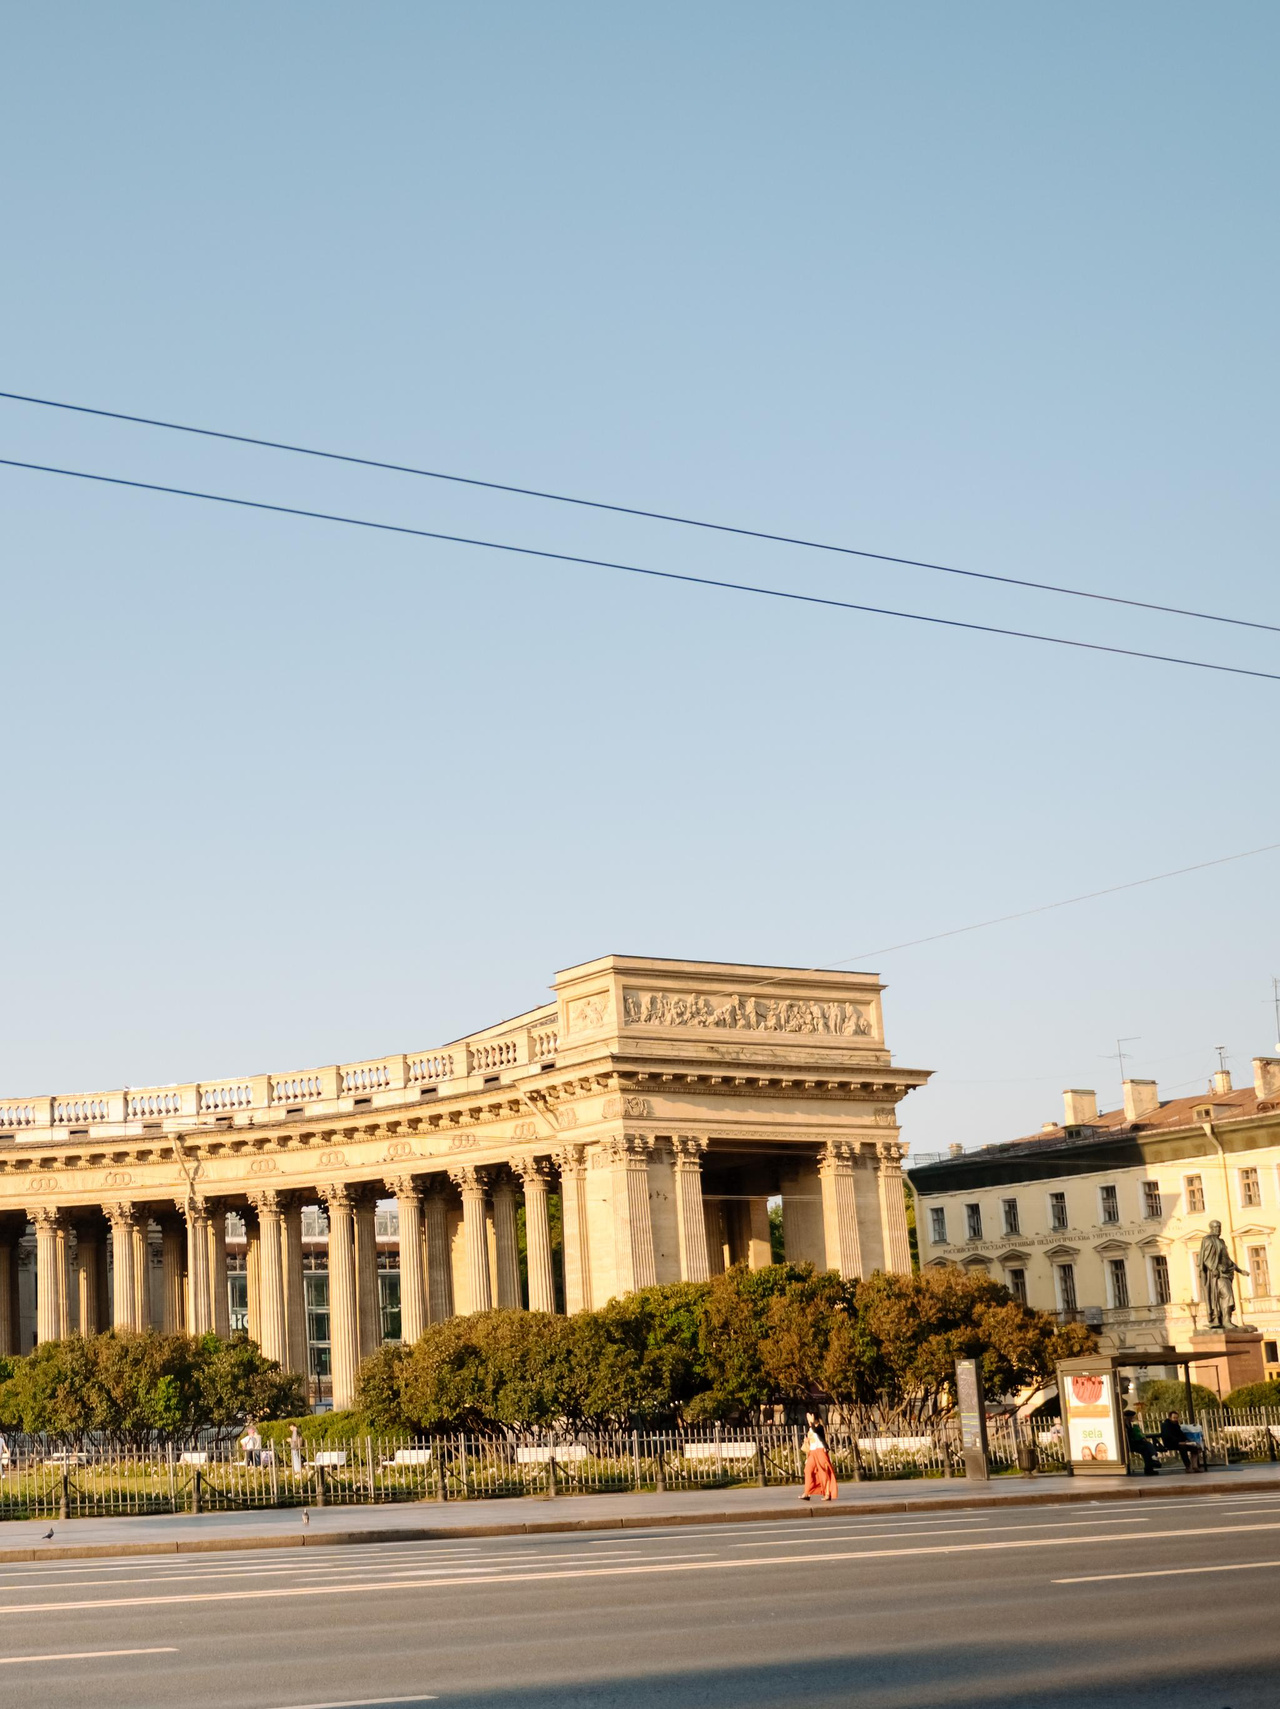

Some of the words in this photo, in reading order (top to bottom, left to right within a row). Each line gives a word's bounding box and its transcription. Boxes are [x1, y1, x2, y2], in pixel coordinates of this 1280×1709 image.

[943, 1245, 979, 1255] РОССИЙСКИЙ
[980, 1240, 1035, 1251] ГОСУДАРСТВЕННЫЙ
[1082, 1428, 1103, 1438] sela
